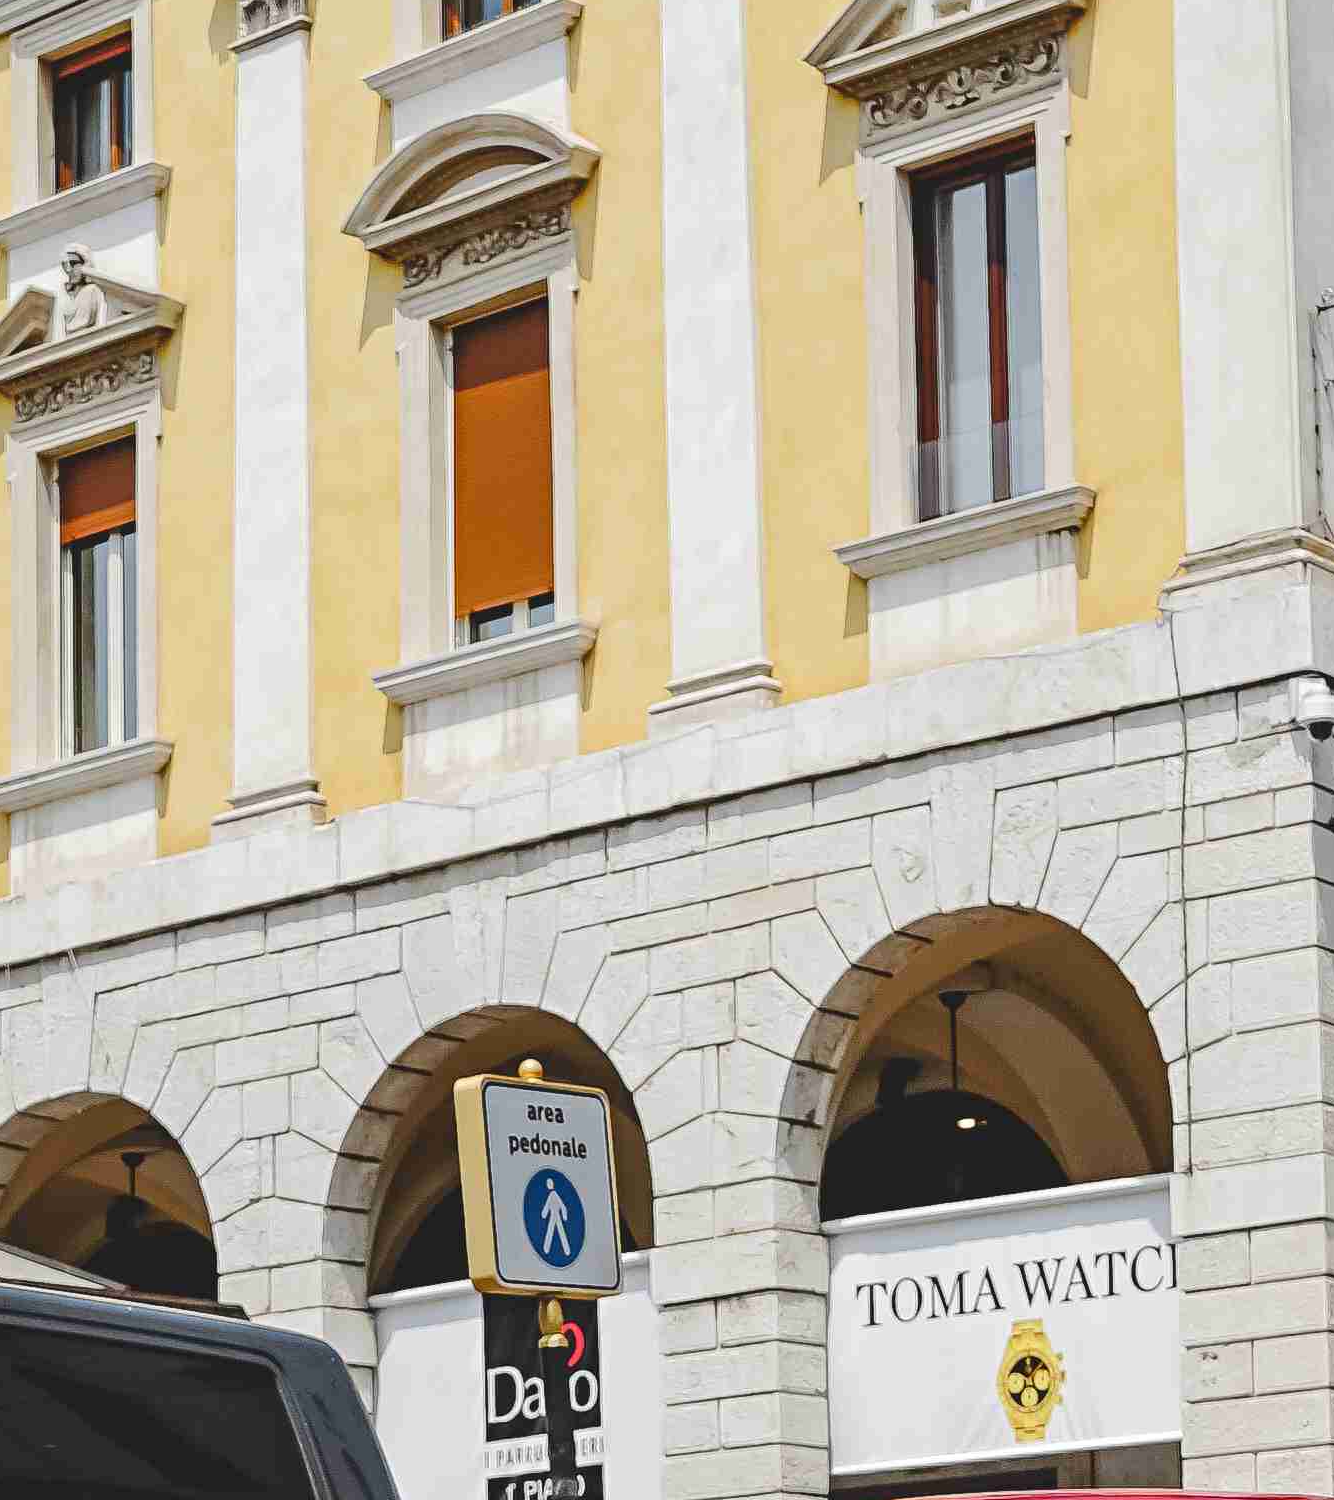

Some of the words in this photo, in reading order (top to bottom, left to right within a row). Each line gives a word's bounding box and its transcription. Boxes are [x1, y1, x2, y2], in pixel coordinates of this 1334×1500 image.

[527, 1104, 565, 1124] area
[508, 1133, 587, 1159] pedonale
[855, 1265, 1007, 1328] TOMA
[487, 1365, 598, 1424] Dao
